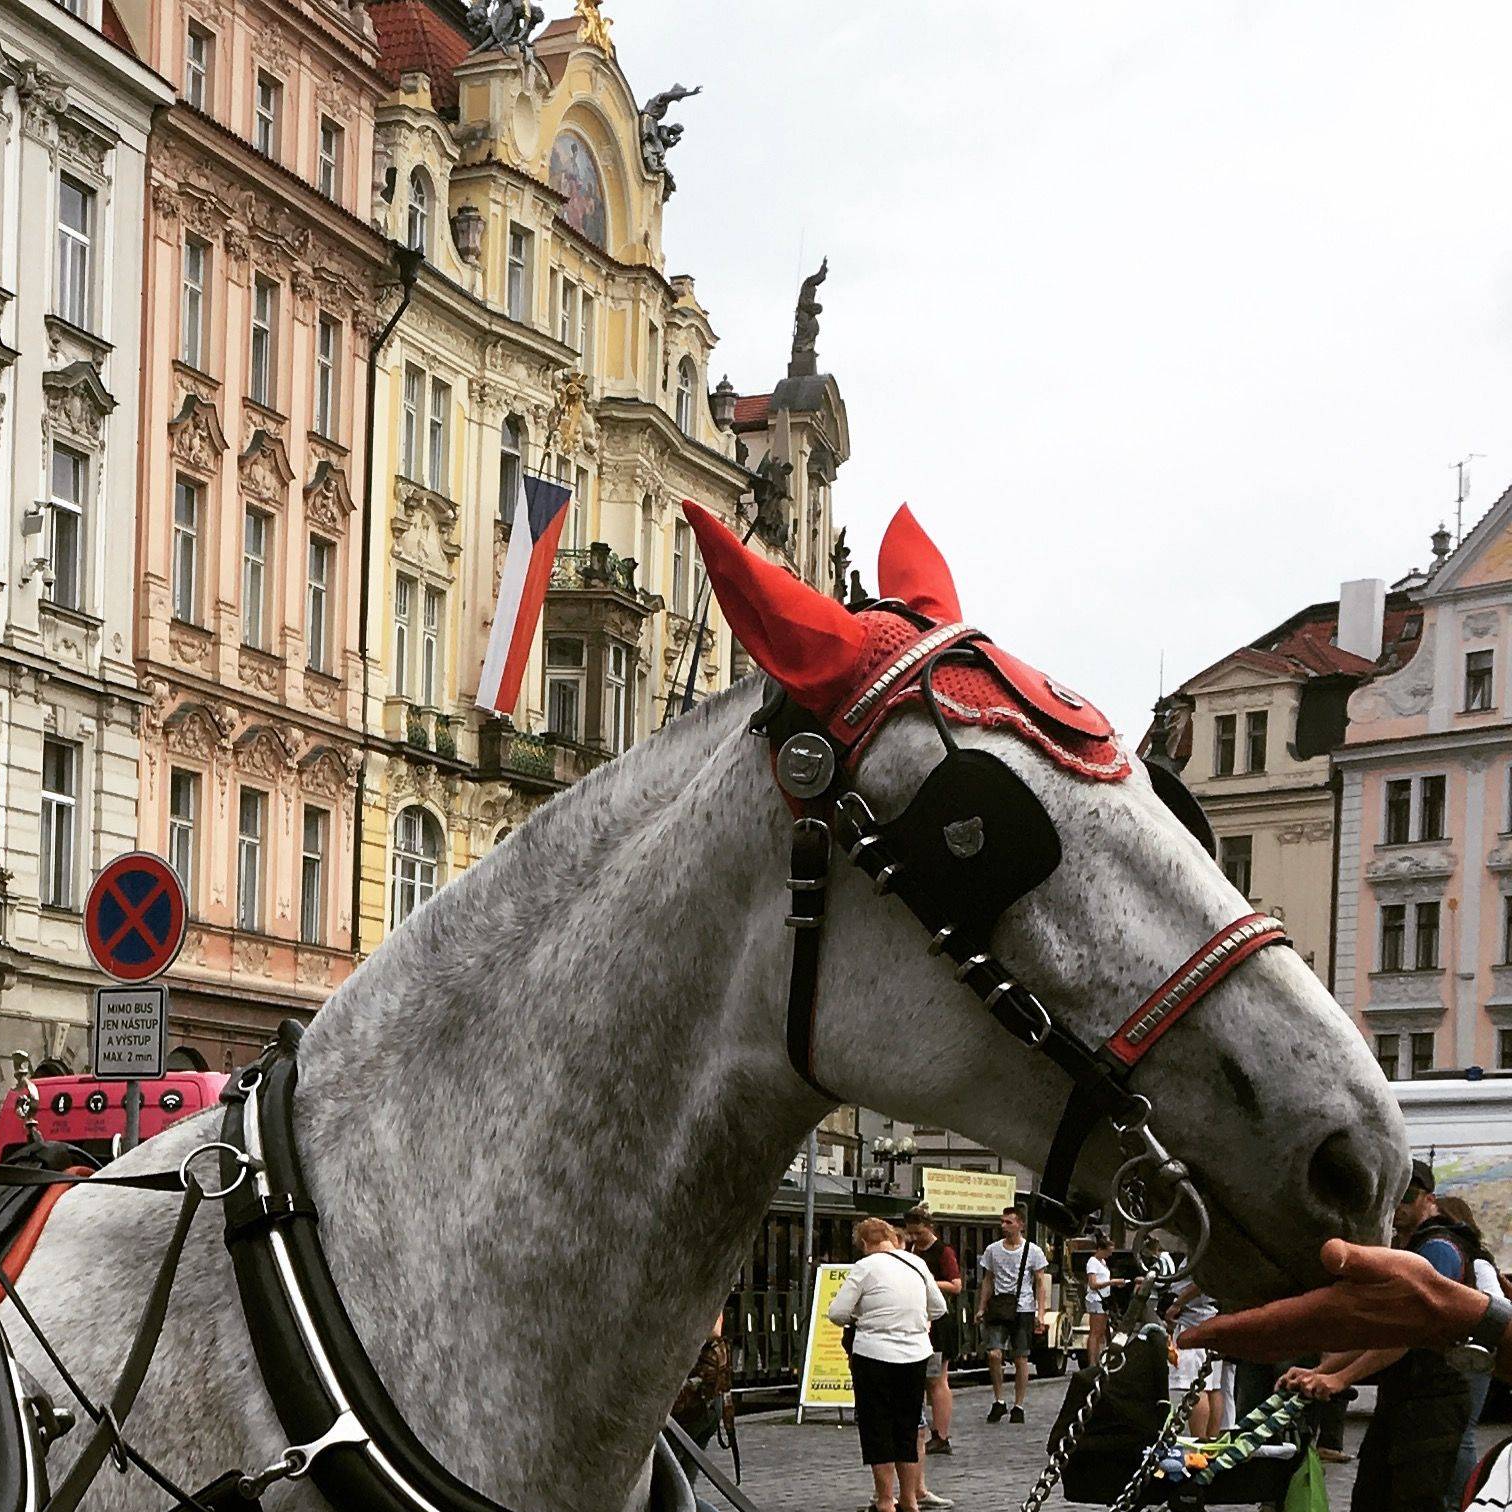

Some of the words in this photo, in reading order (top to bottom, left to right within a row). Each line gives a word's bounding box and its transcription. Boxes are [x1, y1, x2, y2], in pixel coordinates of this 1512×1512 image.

[107, 1003, 131, 1014] MIMO
[134, 1002, 153, 1014] BUS
[101, 1019, 119, 1031] JEN
[121, 1017, 159, 1030] NÁSTUP
[107, 1036, 114, 1046] A
[115, 1033, 152, 1046] VÝSTUP
[127, 1051, 134, 1063] 2
